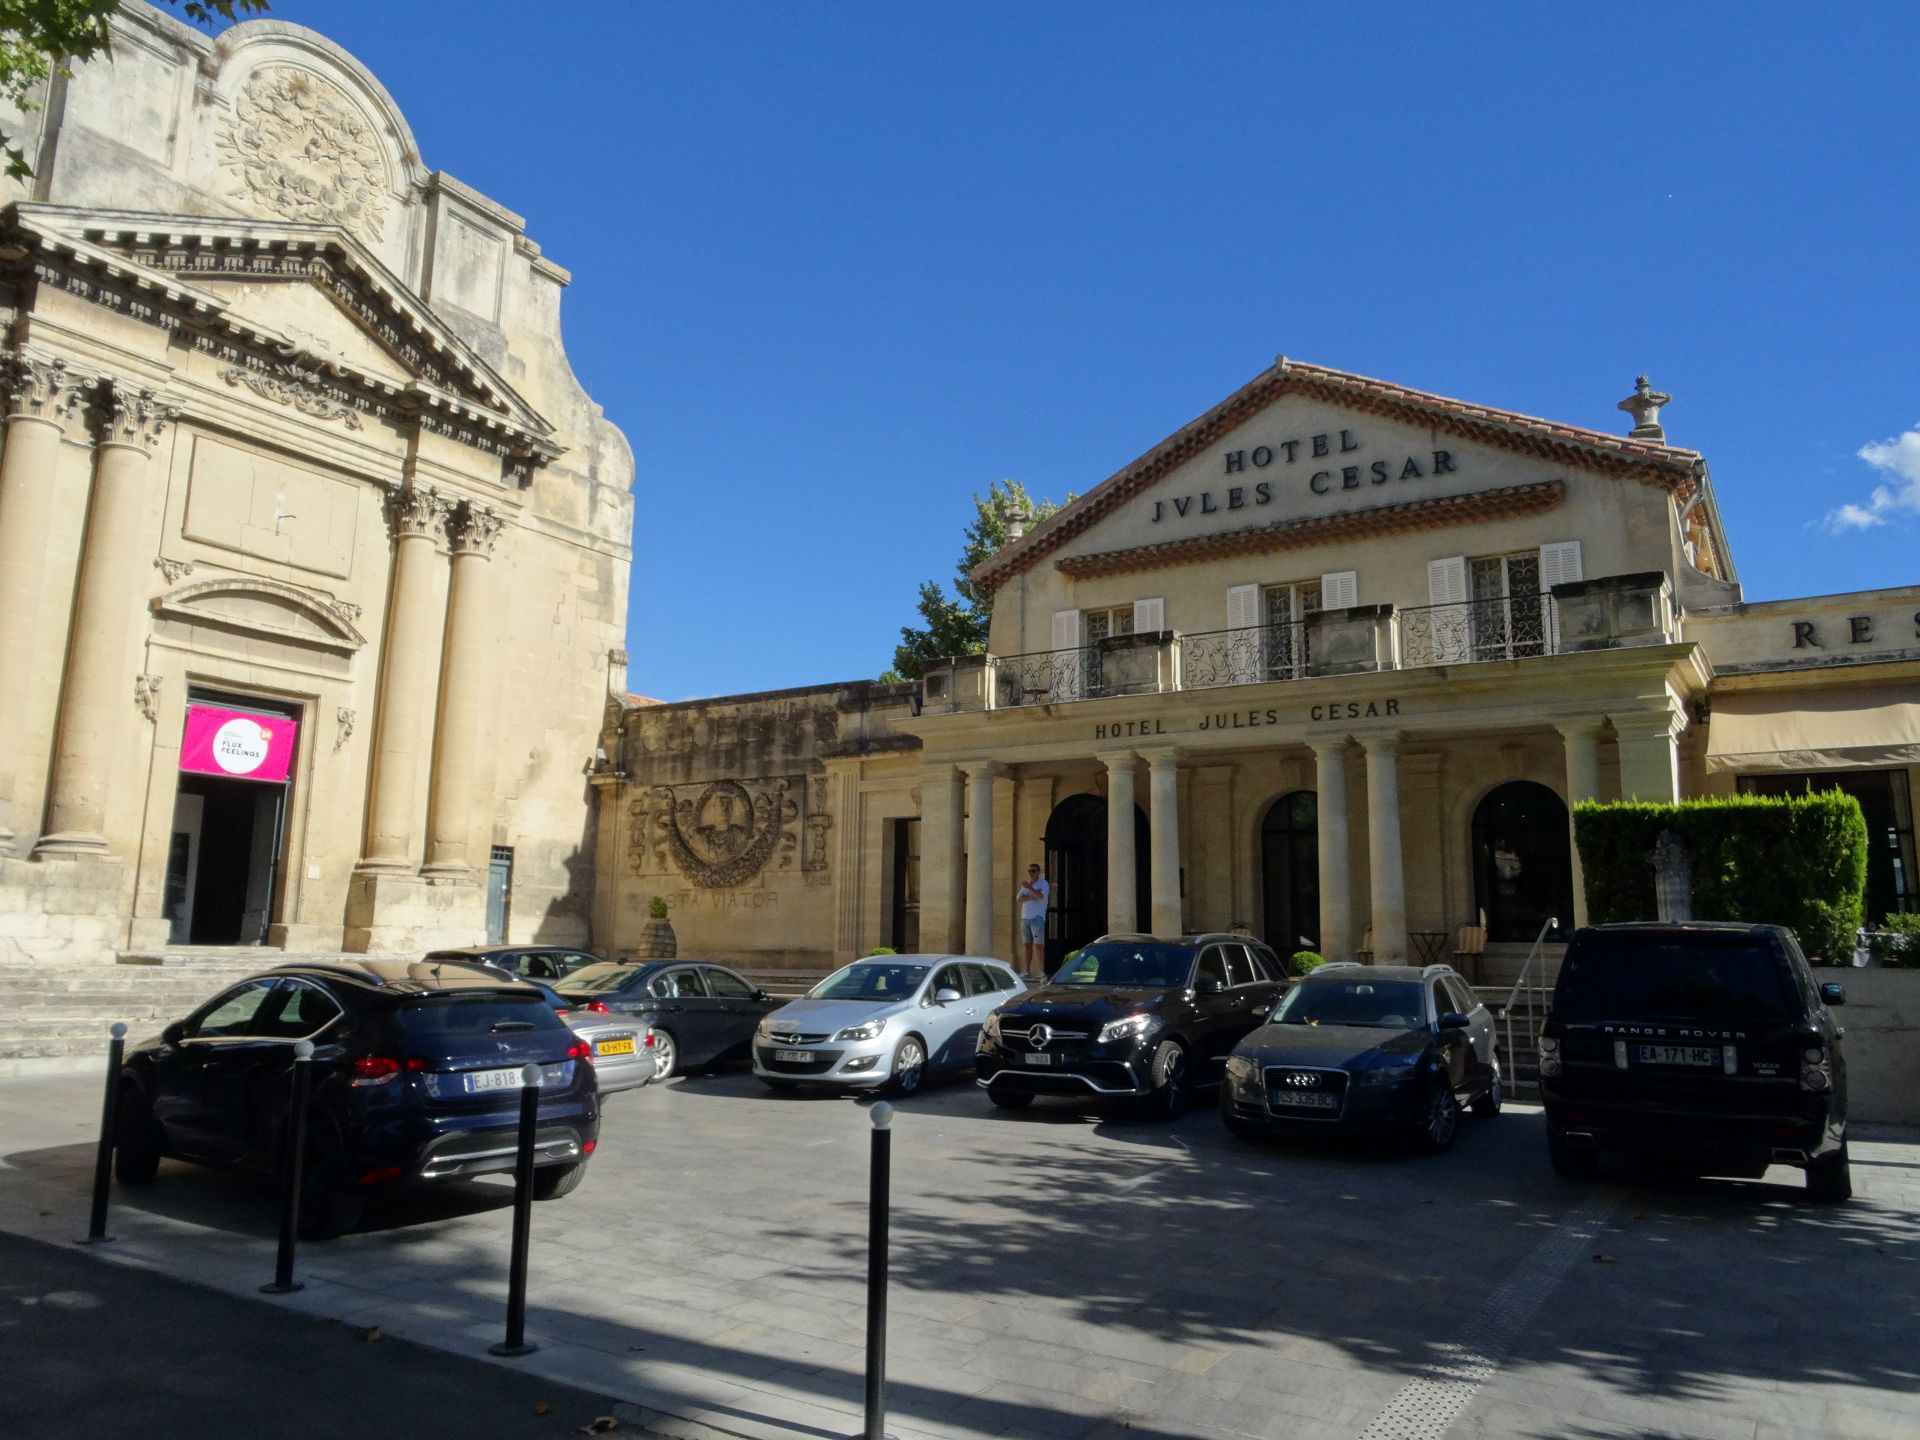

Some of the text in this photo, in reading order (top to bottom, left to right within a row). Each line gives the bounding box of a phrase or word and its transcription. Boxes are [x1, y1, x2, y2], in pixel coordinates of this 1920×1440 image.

[1224, 430, 1358, 474] HOTEL
[1152, 450, 1457, 523] JVLES CESAR
[1095, 699, 1400, 739] HOTEL JULES CESAR
[221, 747, 260, 758] FEELINGS
[222, 740, 242, 749] FLUX
[711, 891, 779, 909] VIATOR
[1604, 1026, 1746, 1040] RANGE ROVER
